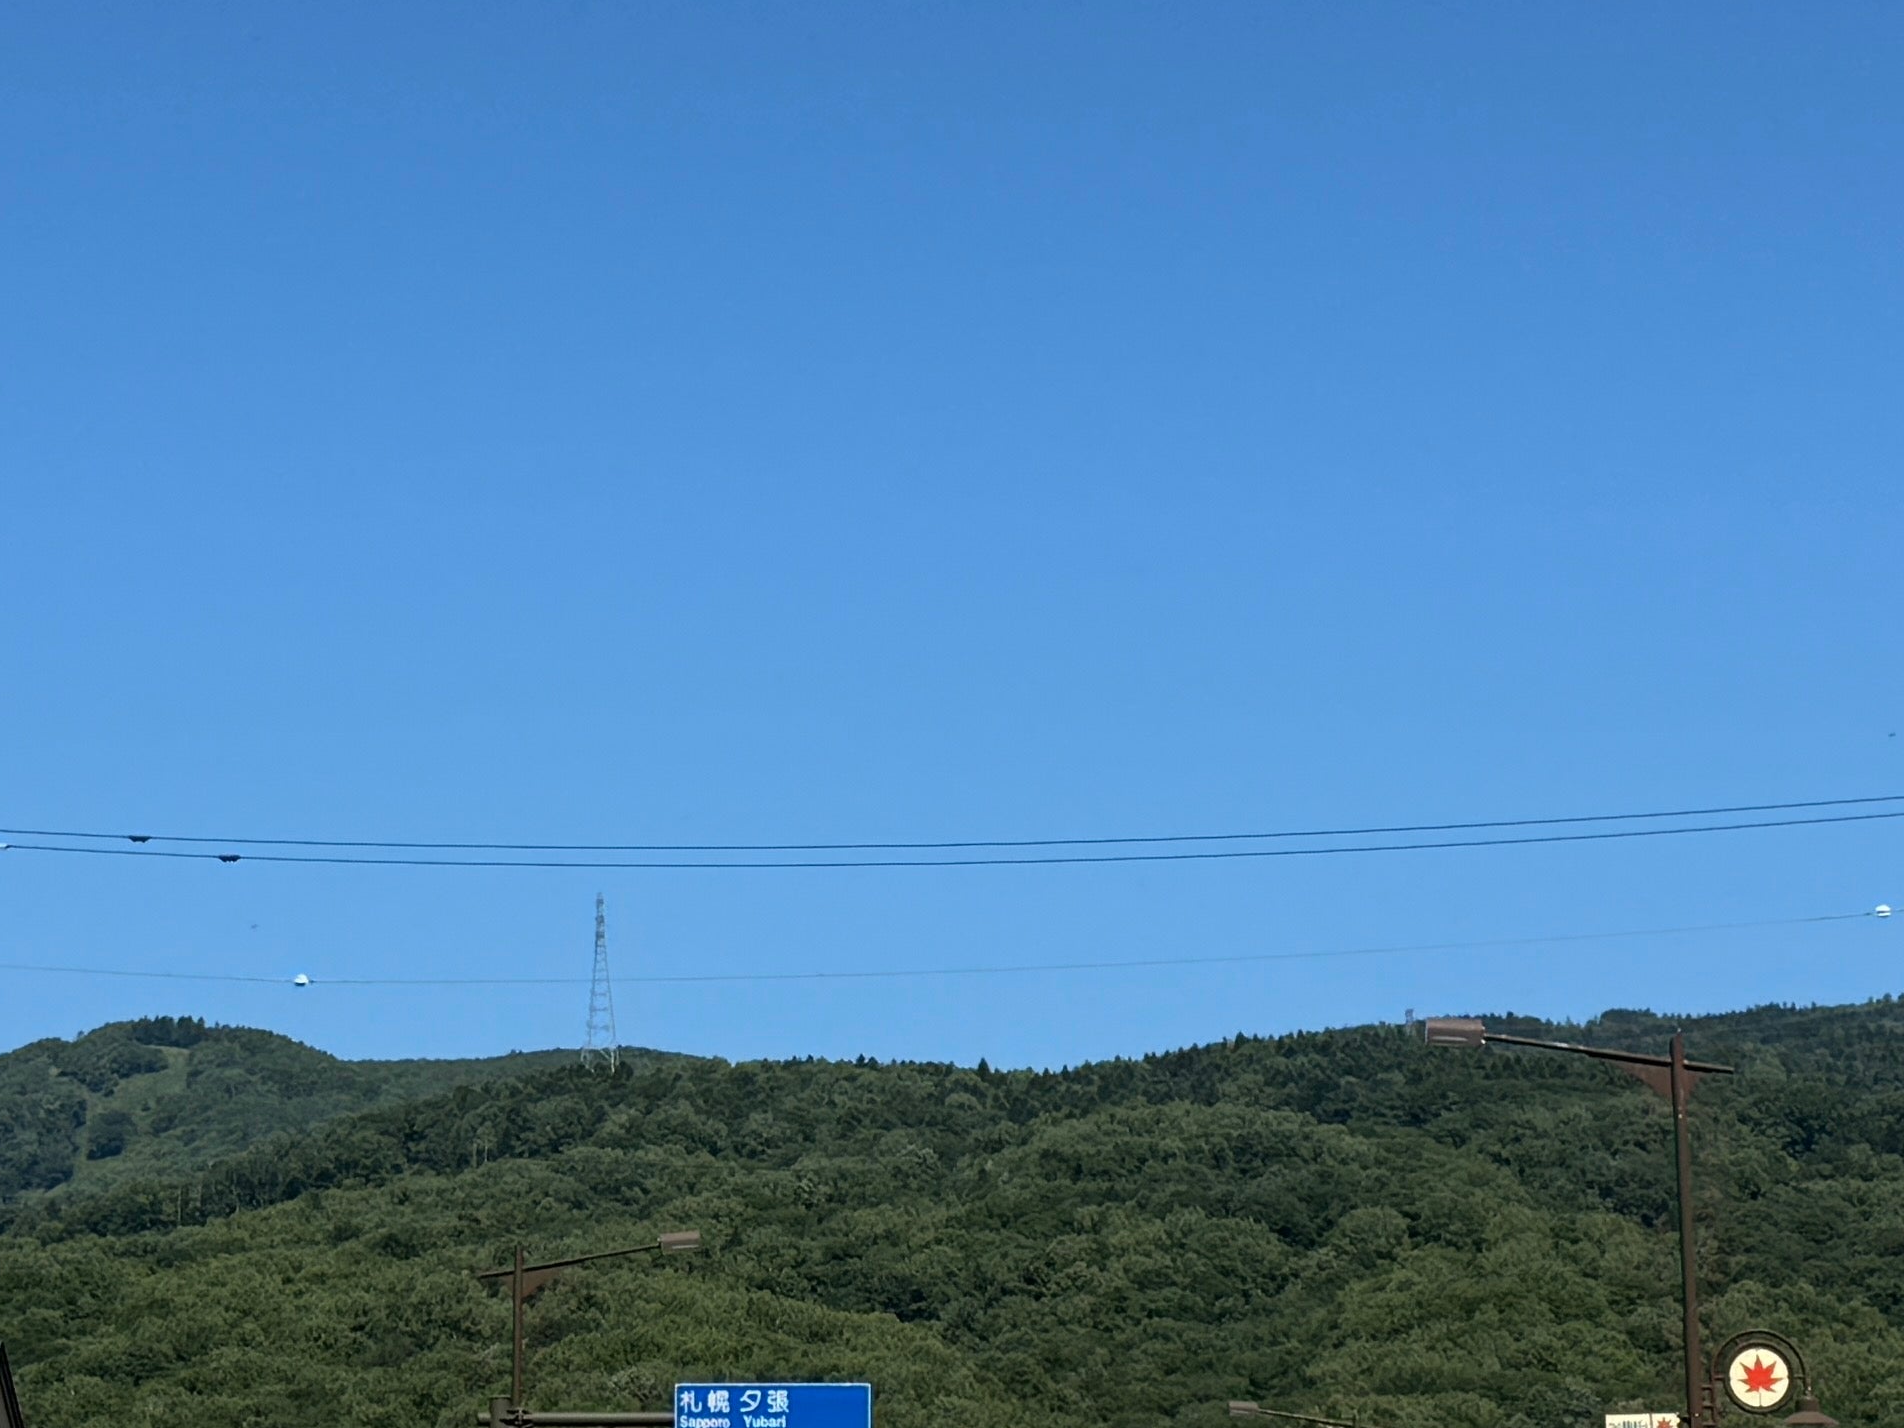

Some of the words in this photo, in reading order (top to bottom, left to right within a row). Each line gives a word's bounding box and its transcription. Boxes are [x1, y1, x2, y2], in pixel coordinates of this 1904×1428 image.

[680, 1390, 730, 1413] 札幌
[740, 1390, 789, 1413] 夕張
[743, 1415, 786, 1428] Yubari
